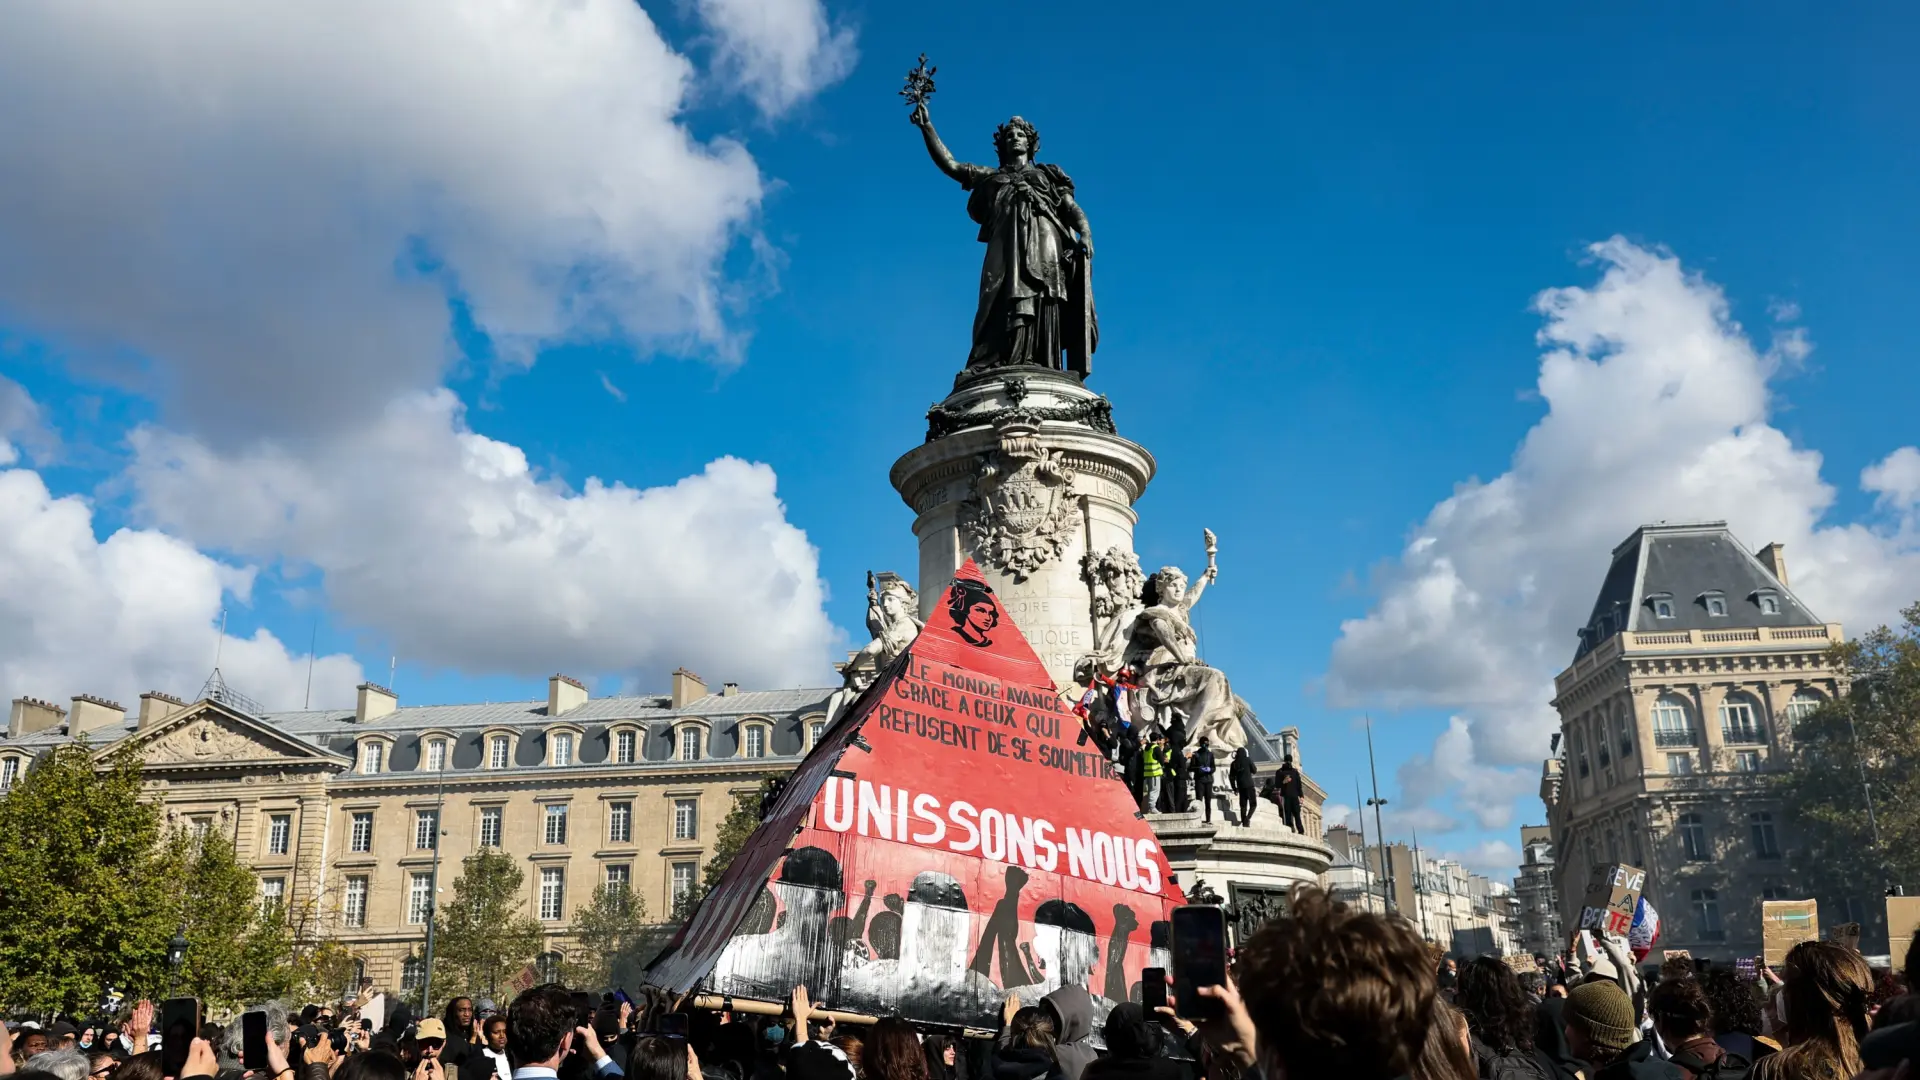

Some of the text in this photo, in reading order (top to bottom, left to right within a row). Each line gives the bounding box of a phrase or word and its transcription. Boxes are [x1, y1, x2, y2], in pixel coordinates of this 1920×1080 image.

[1004, 601, 1050, 614] GLOIRE
[894, 678, 1061, 740] GRACE A CEUX QUI
[909, 653, 931, 682] LE
[943, 671, 1001, 699] MONDE
[1007, 687, 1064, 713] AVANCE
[880, 703, 982, 751] REFUSENT
[987, 730, 1009, 758] DE
[1011, 737, 1032, 762] SE
